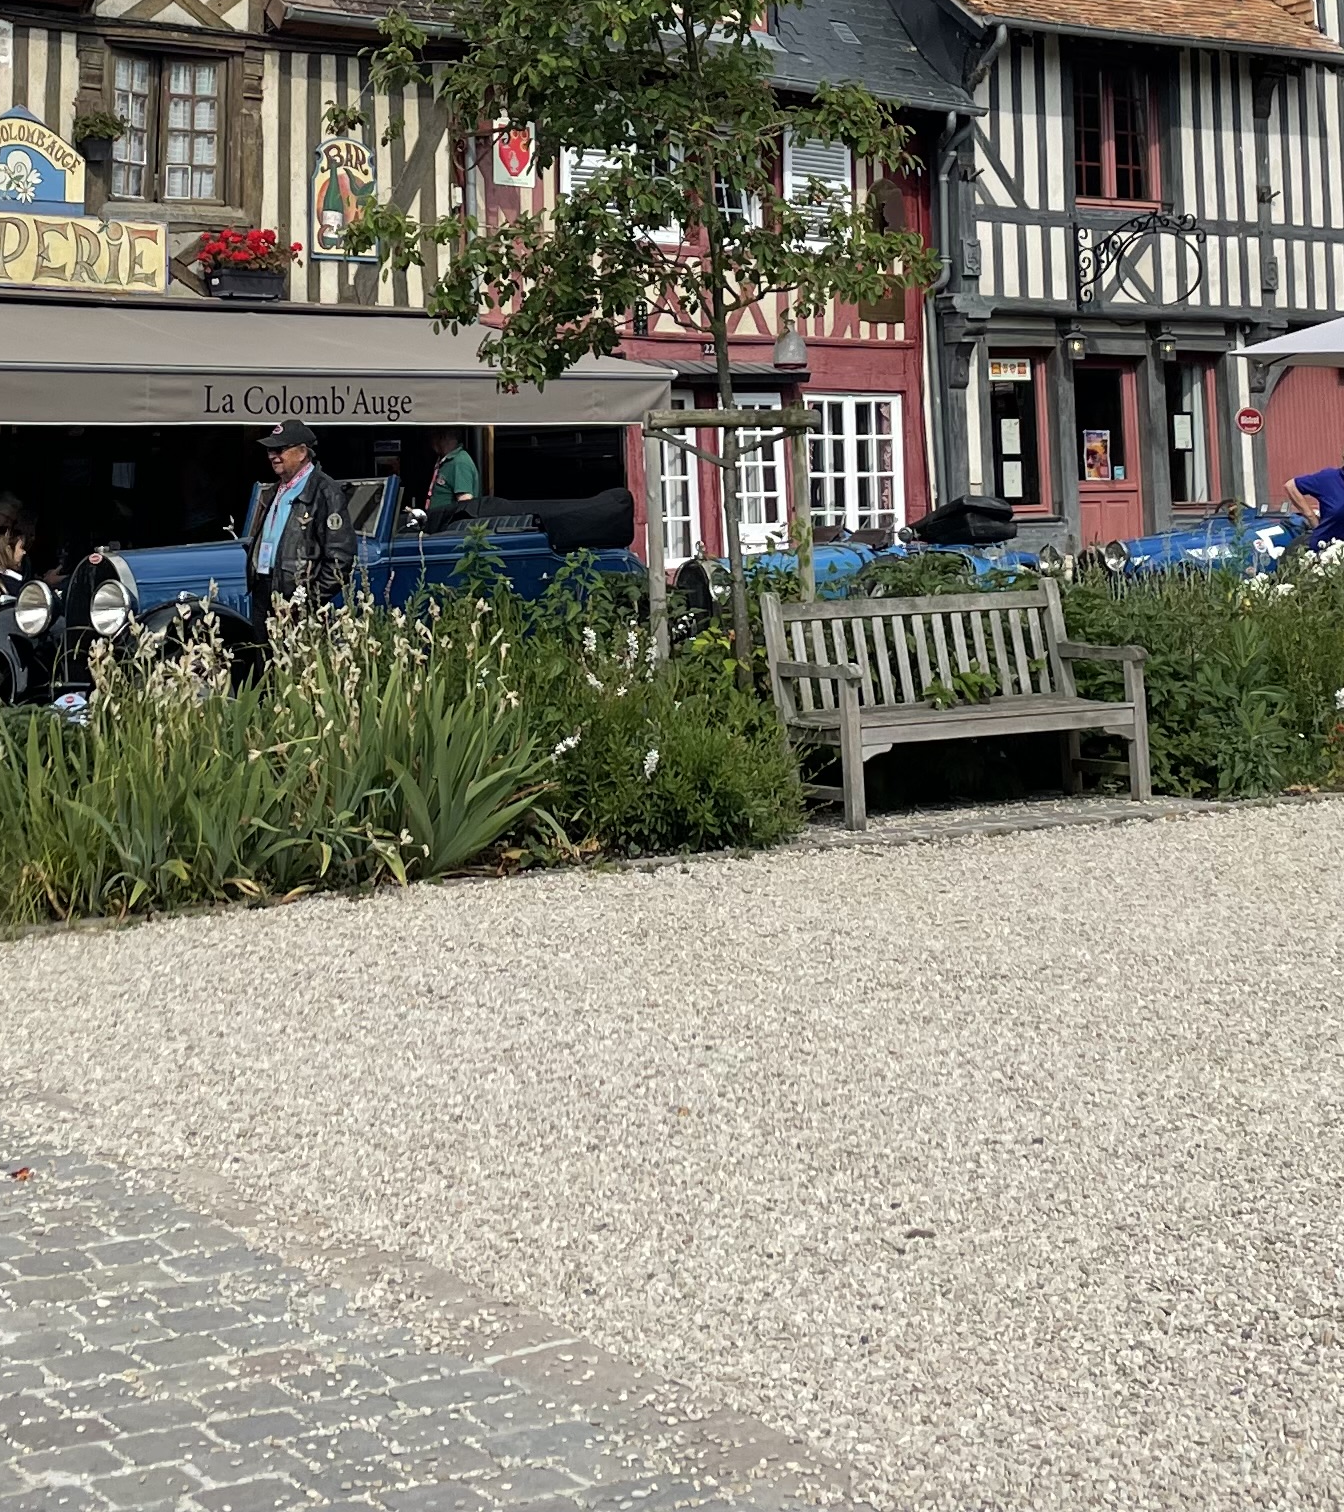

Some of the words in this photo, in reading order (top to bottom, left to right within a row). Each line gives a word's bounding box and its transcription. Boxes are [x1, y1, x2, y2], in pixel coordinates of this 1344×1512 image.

[320, 142, 369, 176] BAR
[703, 343, 715, 354] 22
[203, 385, 235, 413] La
[243, 385, 413, 422] Colomb'Auge
